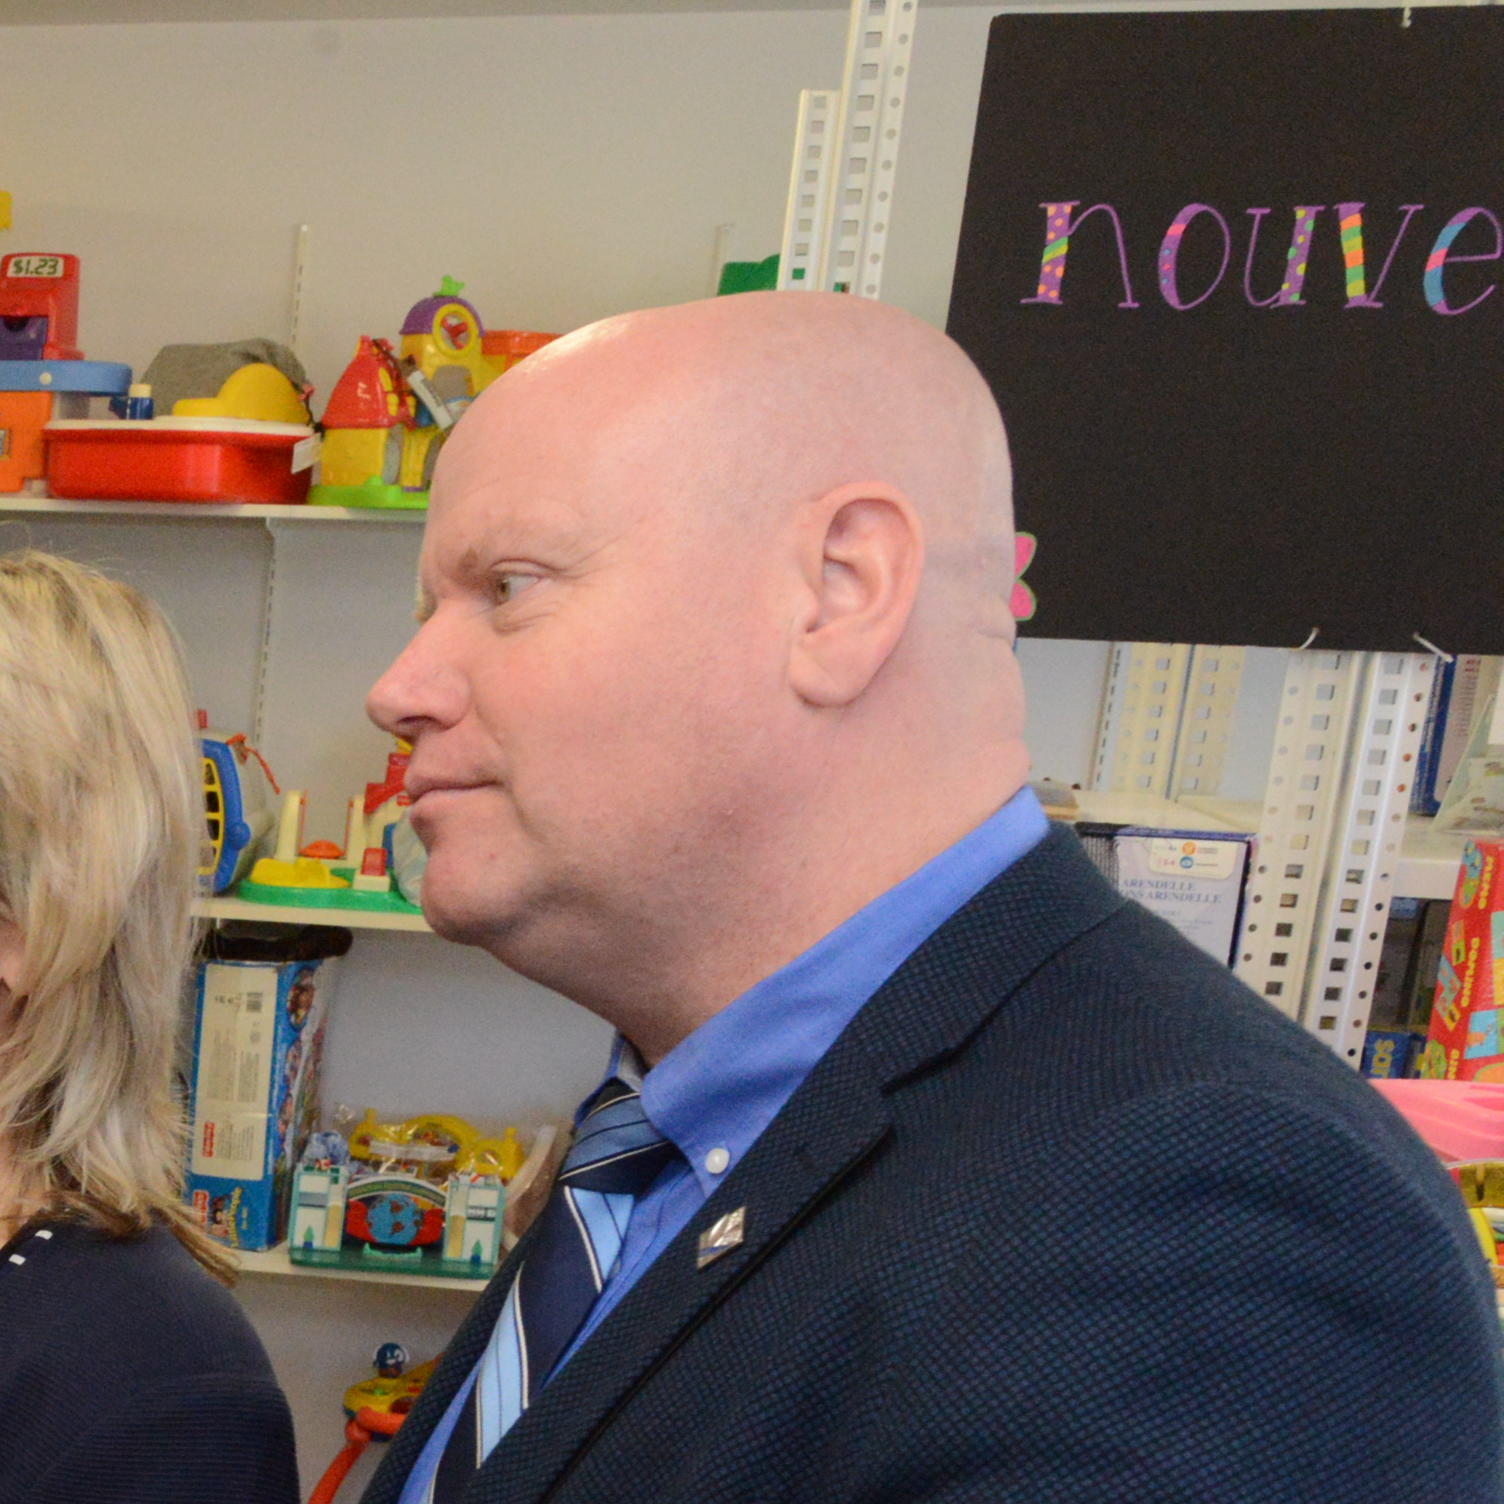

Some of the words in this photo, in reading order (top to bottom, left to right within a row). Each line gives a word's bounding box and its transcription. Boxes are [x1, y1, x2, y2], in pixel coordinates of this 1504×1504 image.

[10, 256, 59, 277] $1.23
[1019, 200, 1503, 315] nouve
[1459, 937, 1481, 1008] DOMINO
